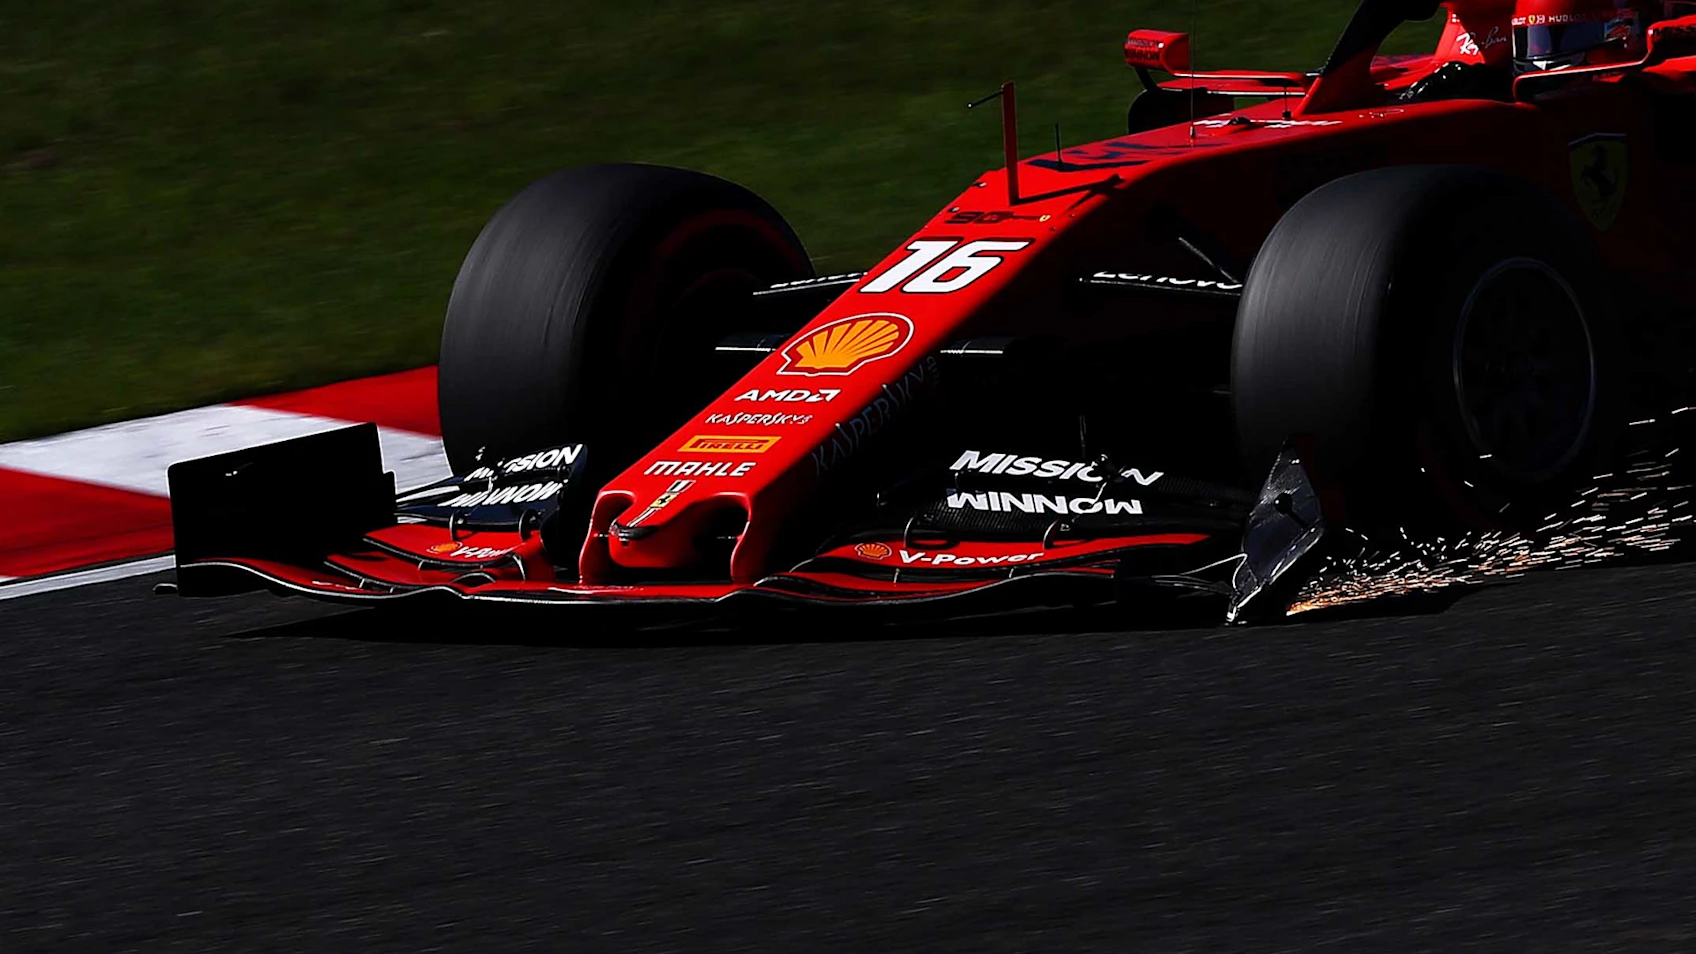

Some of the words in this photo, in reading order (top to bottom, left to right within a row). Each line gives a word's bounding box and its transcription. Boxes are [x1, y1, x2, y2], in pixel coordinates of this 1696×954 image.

[858, 239, 1031, 293] 16
[734, 388, 808, 402] AMD
[697, 439, 764, 451] PIRELLI
[644, 461, 757, 476] MAHLE
[946, 491, 1144, 514] WINNOW
[898, 548, 1045, 566] V-Power
